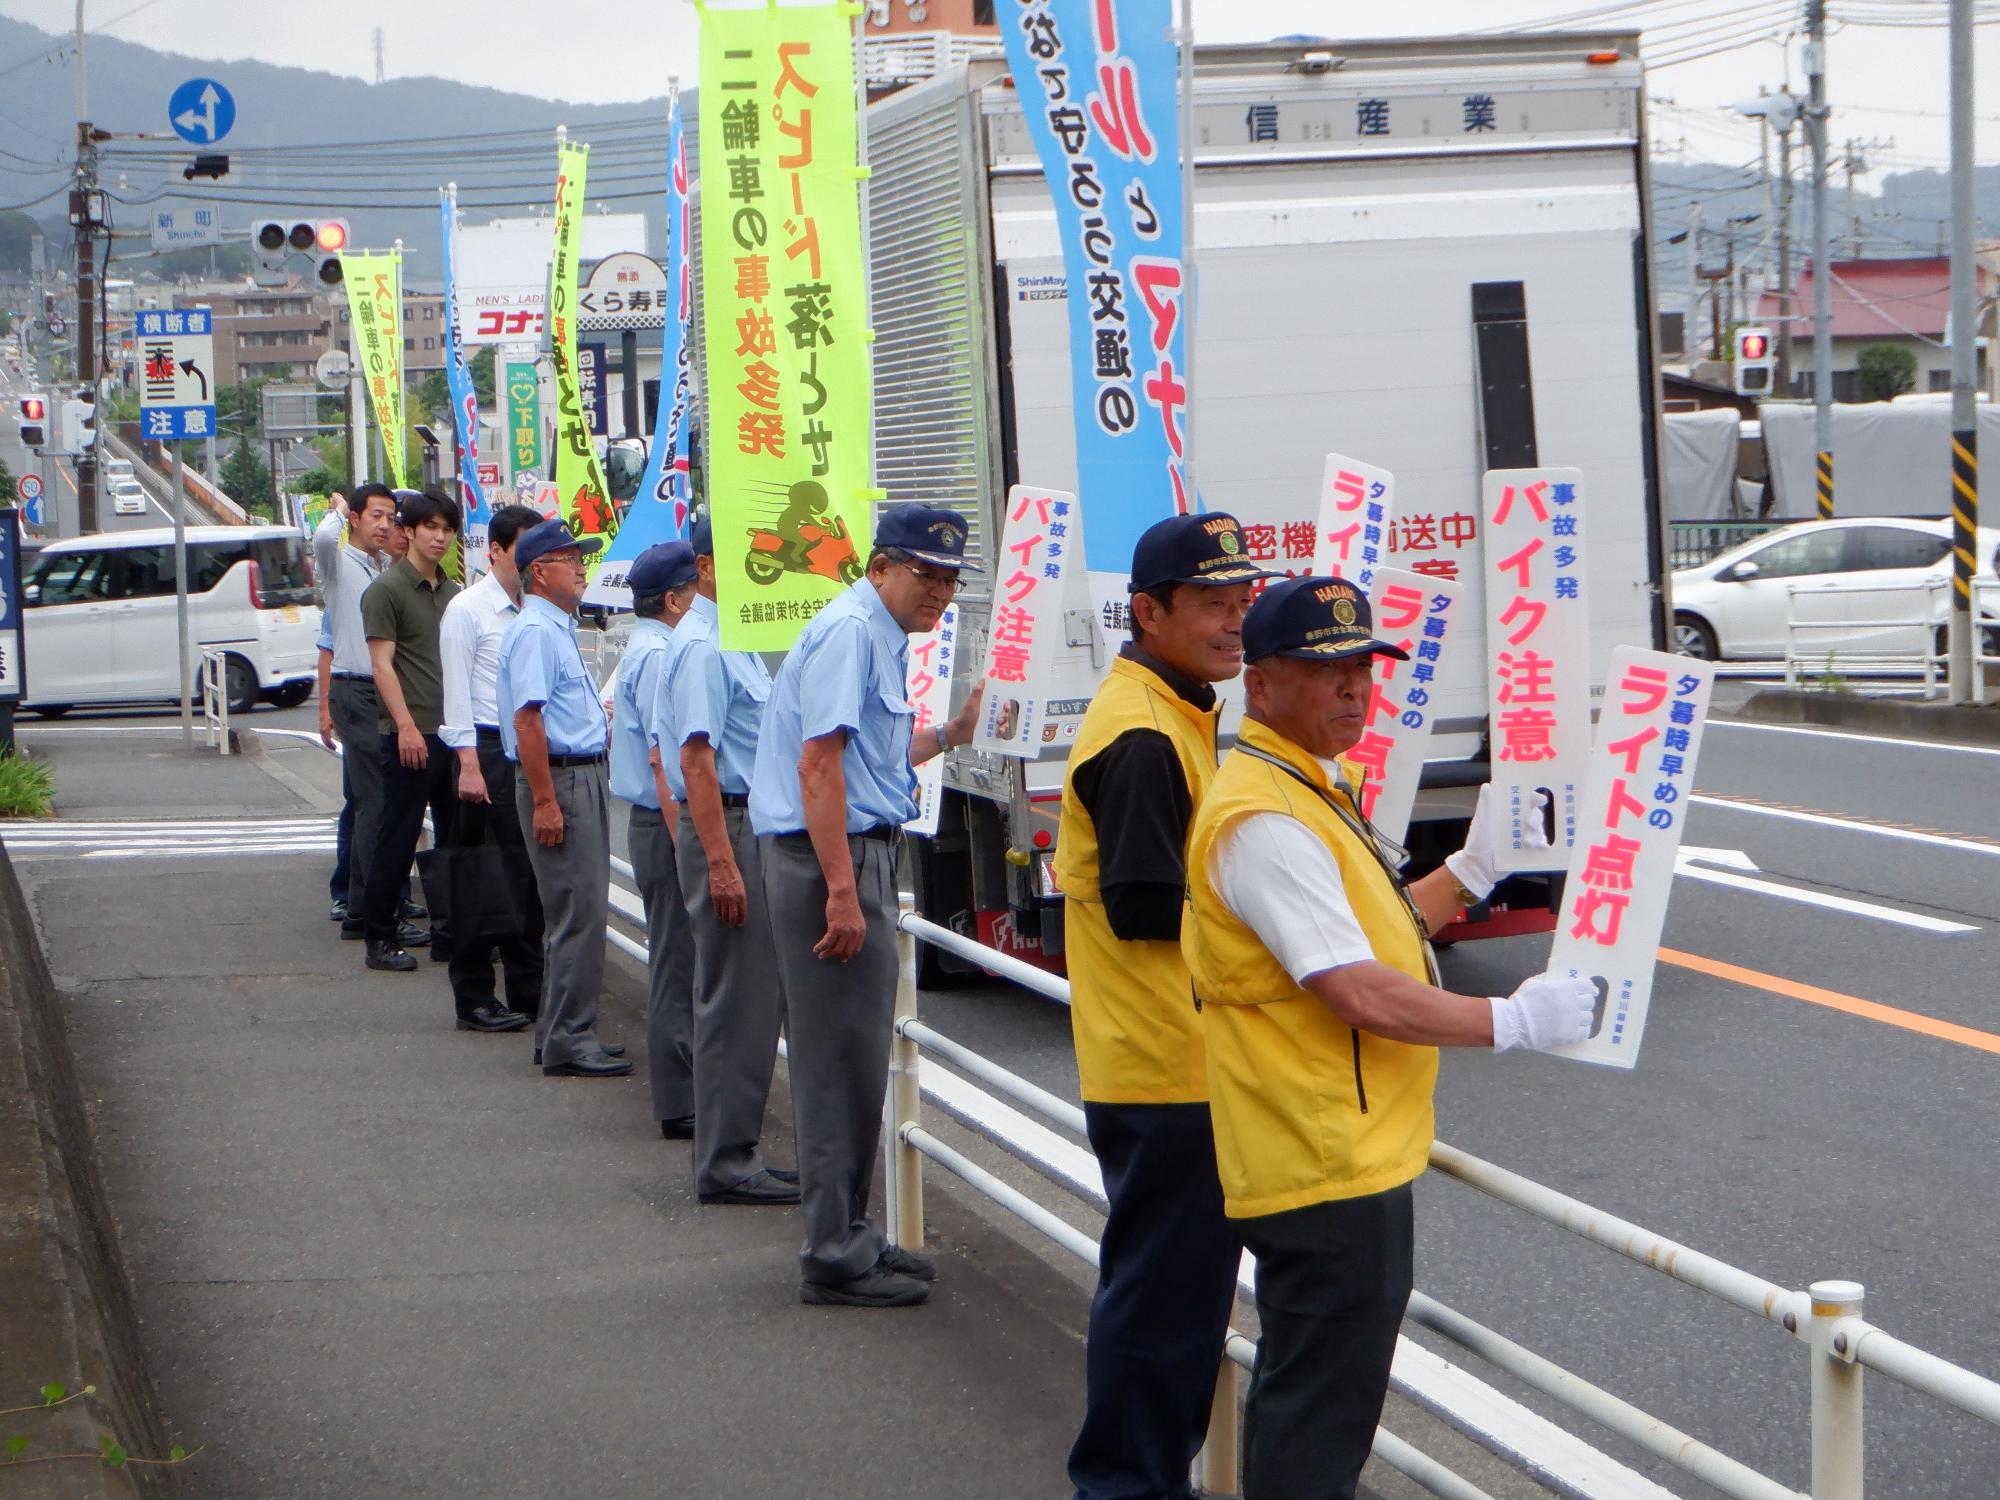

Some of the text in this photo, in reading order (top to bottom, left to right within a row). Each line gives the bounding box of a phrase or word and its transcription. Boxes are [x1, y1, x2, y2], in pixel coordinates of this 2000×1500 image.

[143, 314, 206, 333] 横断者
[475, 295, 510, 305] MEN'S
[477, 310, 544, 335] コナ
[149, 410, 208, 435] 注意
[514, 407, 536, 466] 下取り
[1043, 501, 1070, 579] 事故多発
[1359, 481, 1387, 598] 夕暮時早め
[1552, 483, 1579, 599] 事故多発
[988, 496, 1053, 682] バイク注意
[1491, 480, 1557, 762] バイク注意
[938, 610, 955, 678] 事故多発
[1402, 594, 1452, 729] 夕暮時早めの
[1648, 674, 1702, 830] 夕暮時早めの
[1570, 664, 1670, 947] ライト点灯
